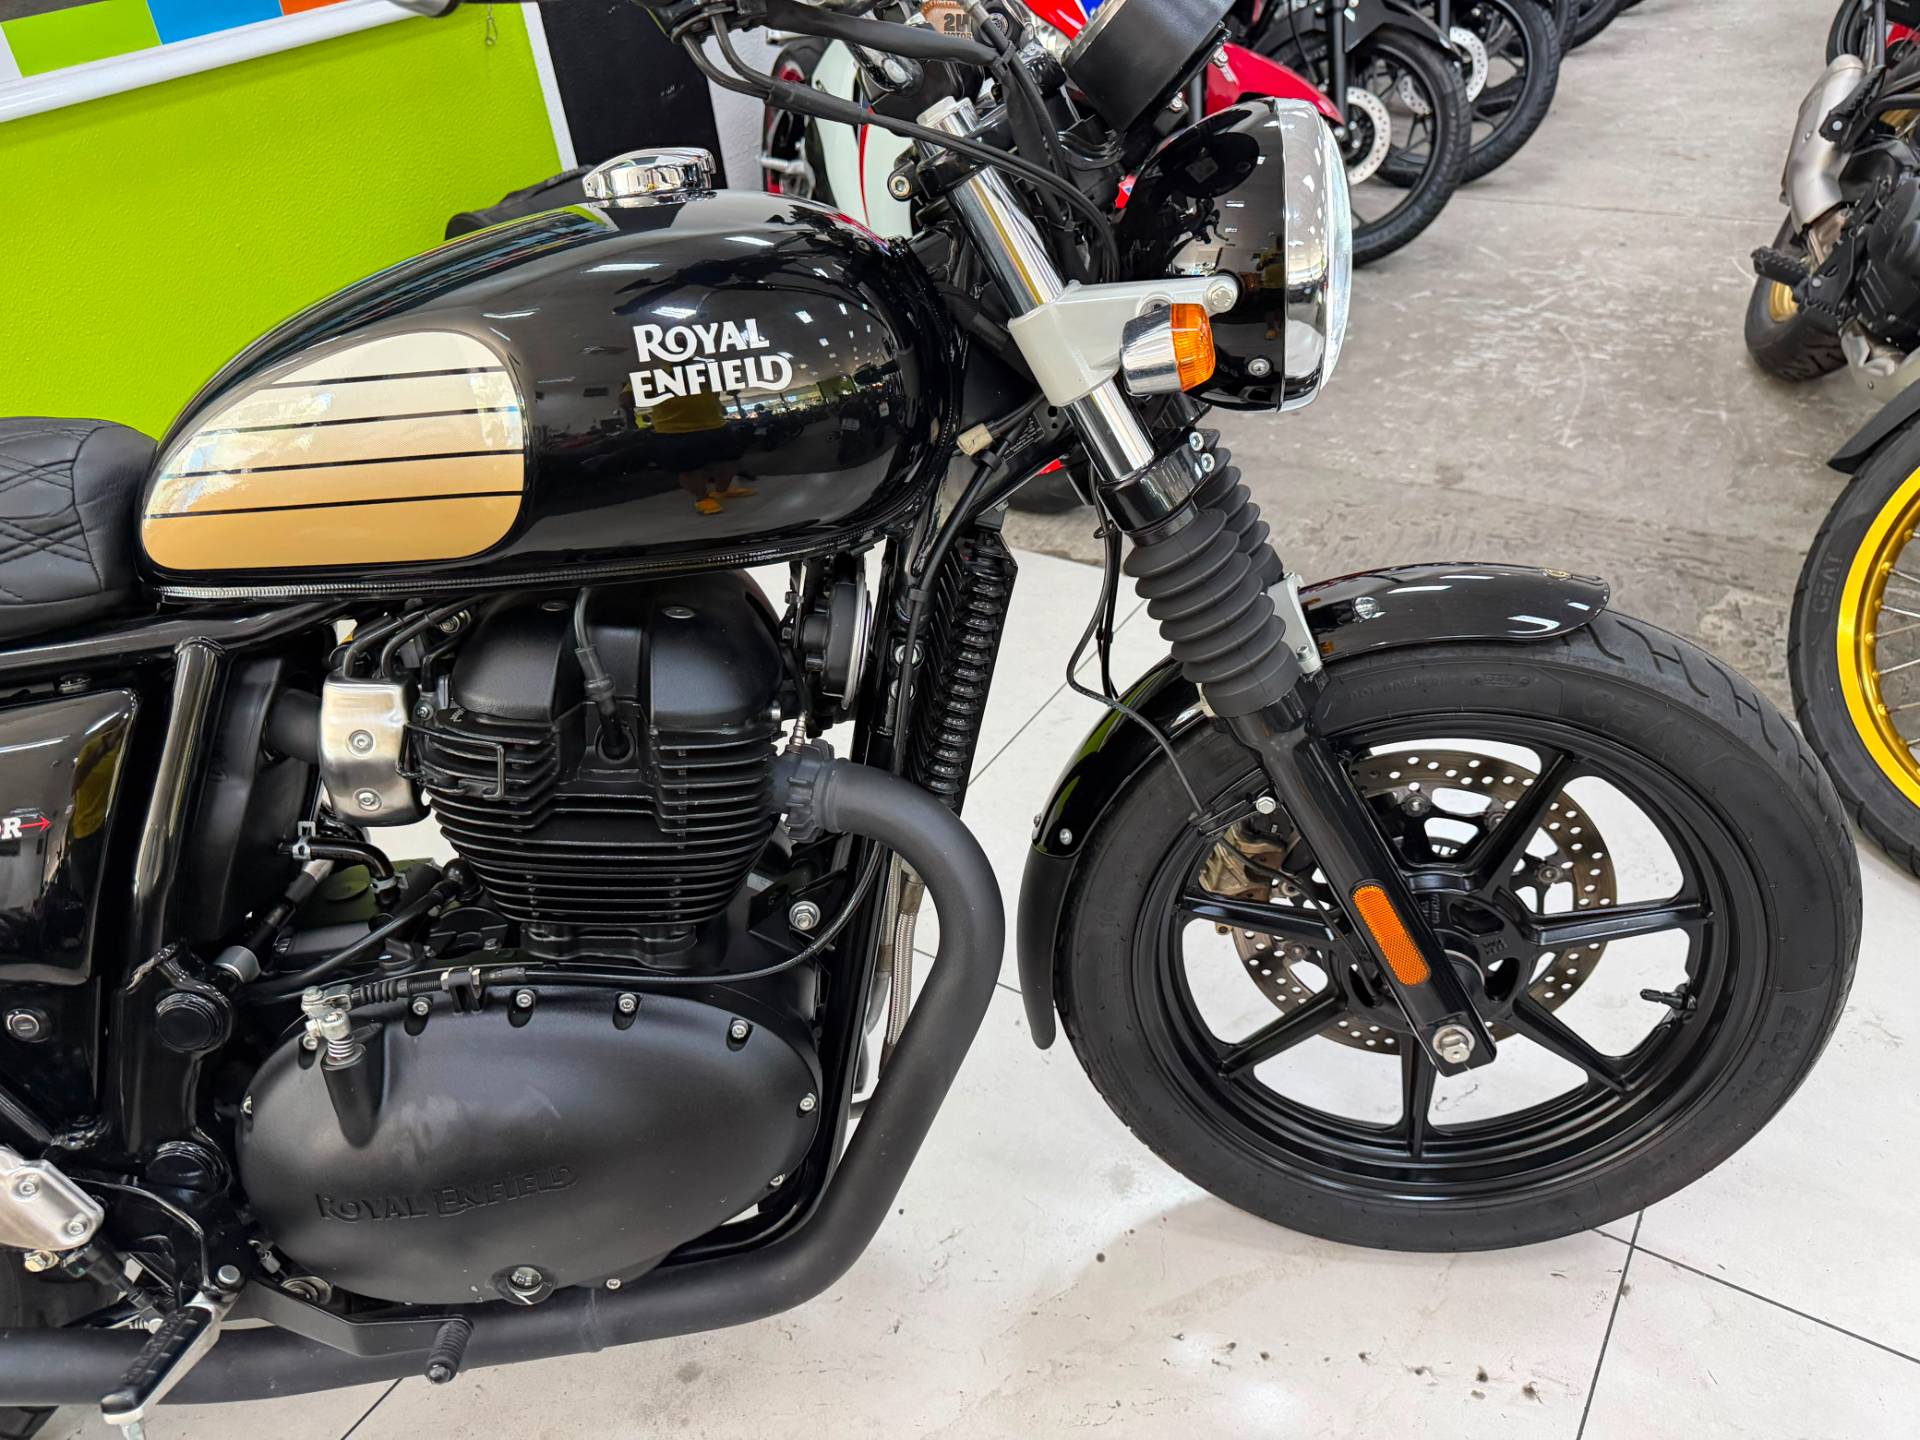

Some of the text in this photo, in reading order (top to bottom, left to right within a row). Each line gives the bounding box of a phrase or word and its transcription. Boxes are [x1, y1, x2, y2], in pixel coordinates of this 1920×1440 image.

[633, 318, 770, 363] ROYAL
[629, 354, 793, 408] ENFIELD
[0, 816, 23, 840] R
[314, 1164, 579, 1224] ROYAL ENFIELD
